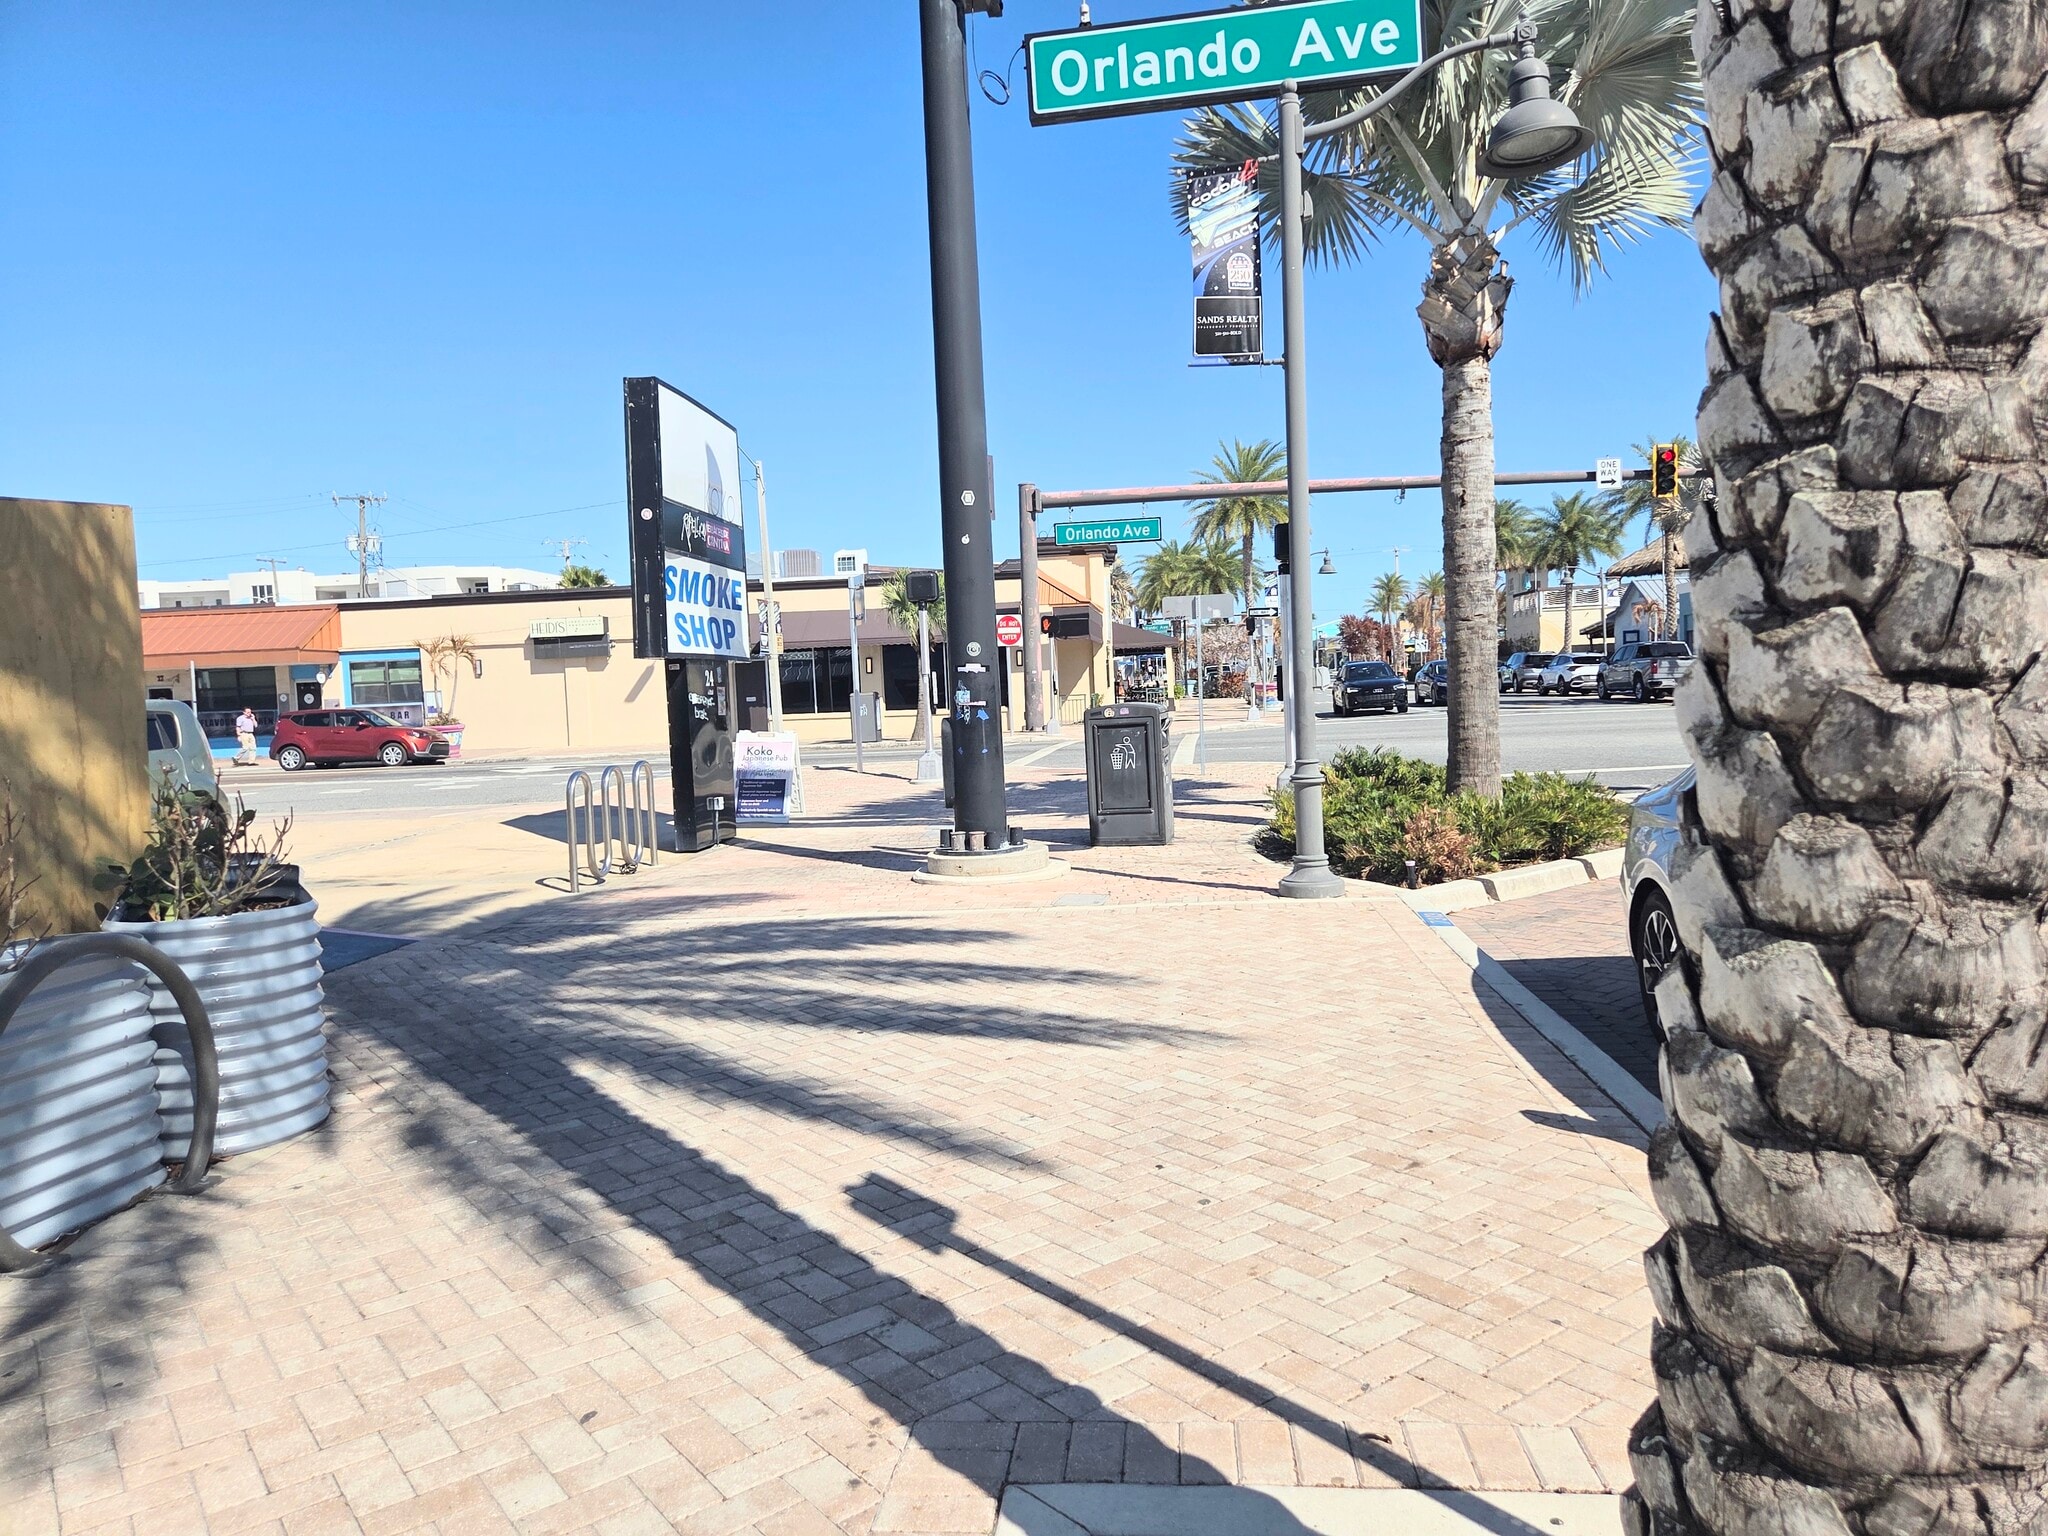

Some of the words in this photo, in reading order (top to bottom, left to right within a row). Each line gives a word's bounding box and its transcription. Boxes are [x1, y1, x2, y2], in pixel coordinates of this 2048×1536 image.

[1051, 29, 1261, 97] Orlando
[1289, 18, 1400, 67] Ave
[1191, 178, 1242, 207] COCOA
[1213, 220, 1259, 249] BEACH
[1230, 270, 1251, 281] 250
[1197, 316, 1225, 324] SANDS
[1226, 315, 1259, 323] REALTY
[1601, 460, 1617, 468] ONE
[1601, 469, 1618, 477] WAY
[1065, 526, 1120, 541] Orlando
[1123, 524, 1151, 538] Ave
[665, 565, 742, 611] SMOKE
[674, 612, 736, 650] SHOP
[1001, 633, 1017, 641] ENTER
[704, 669, 714, 687] 24
[390, 710, 410, 720] BAR
[747, 745, 773, 756] Koko
